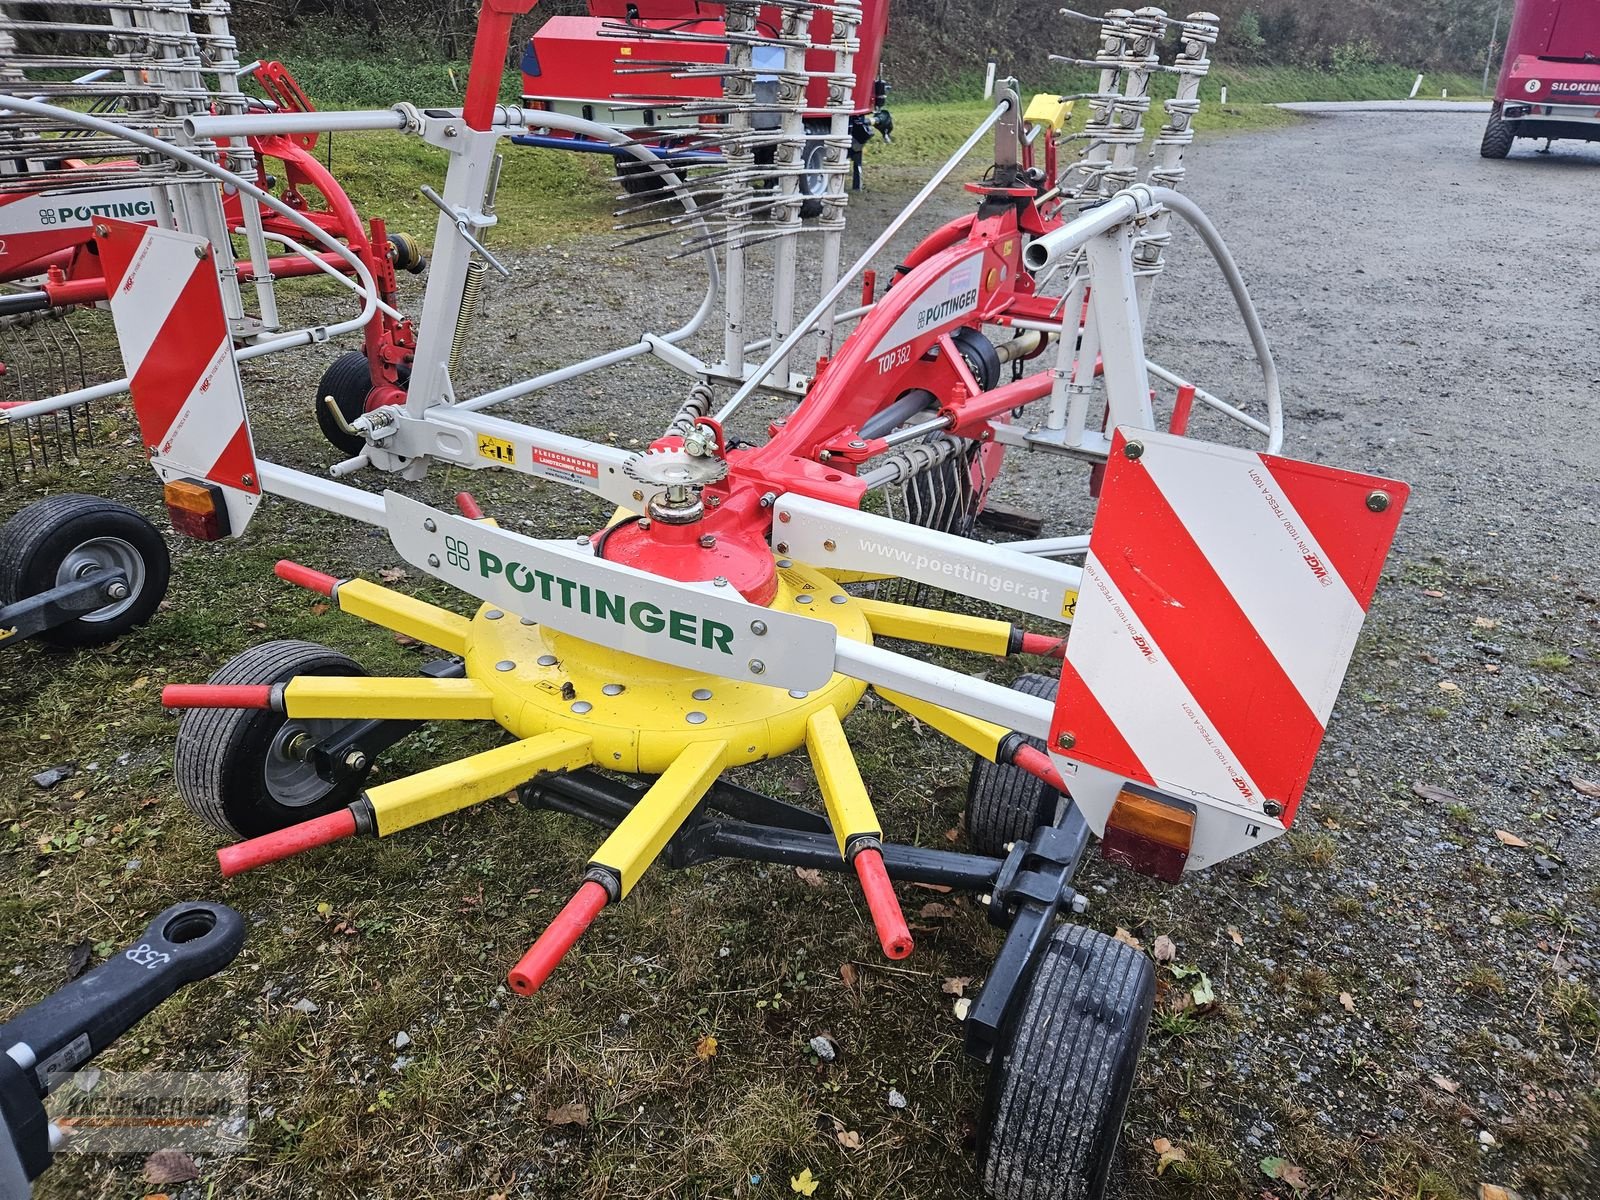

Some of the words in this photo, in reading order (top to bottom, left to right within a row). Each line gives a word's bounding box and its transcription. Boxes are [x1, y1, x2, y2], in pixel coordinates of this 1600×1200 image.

[1529, 81, 1536, 91] 8
[1551, 82, 1600, 91] SILOKIN
[878, 353, 897, 375] TOP
[896, 345, 911, 367] 382
[534, 448, 597, 470] FLEISCHANDERL
[539, 457, 576, 471] LANDTECHNIK
[575, 465, 592, 475] GmbH
[1248, 468, 1265, 489] 10071
[1284, 521, 1300, 540] 11030
[1297, 541, 1310, 555] DIN
[858, 538, 1050, 604] www.poettinger.at
[1303, 554, 1326, 578] WGF
[1132, 635, 1153, 657] WGF
[1232, 777, 1253, 799] WGF
